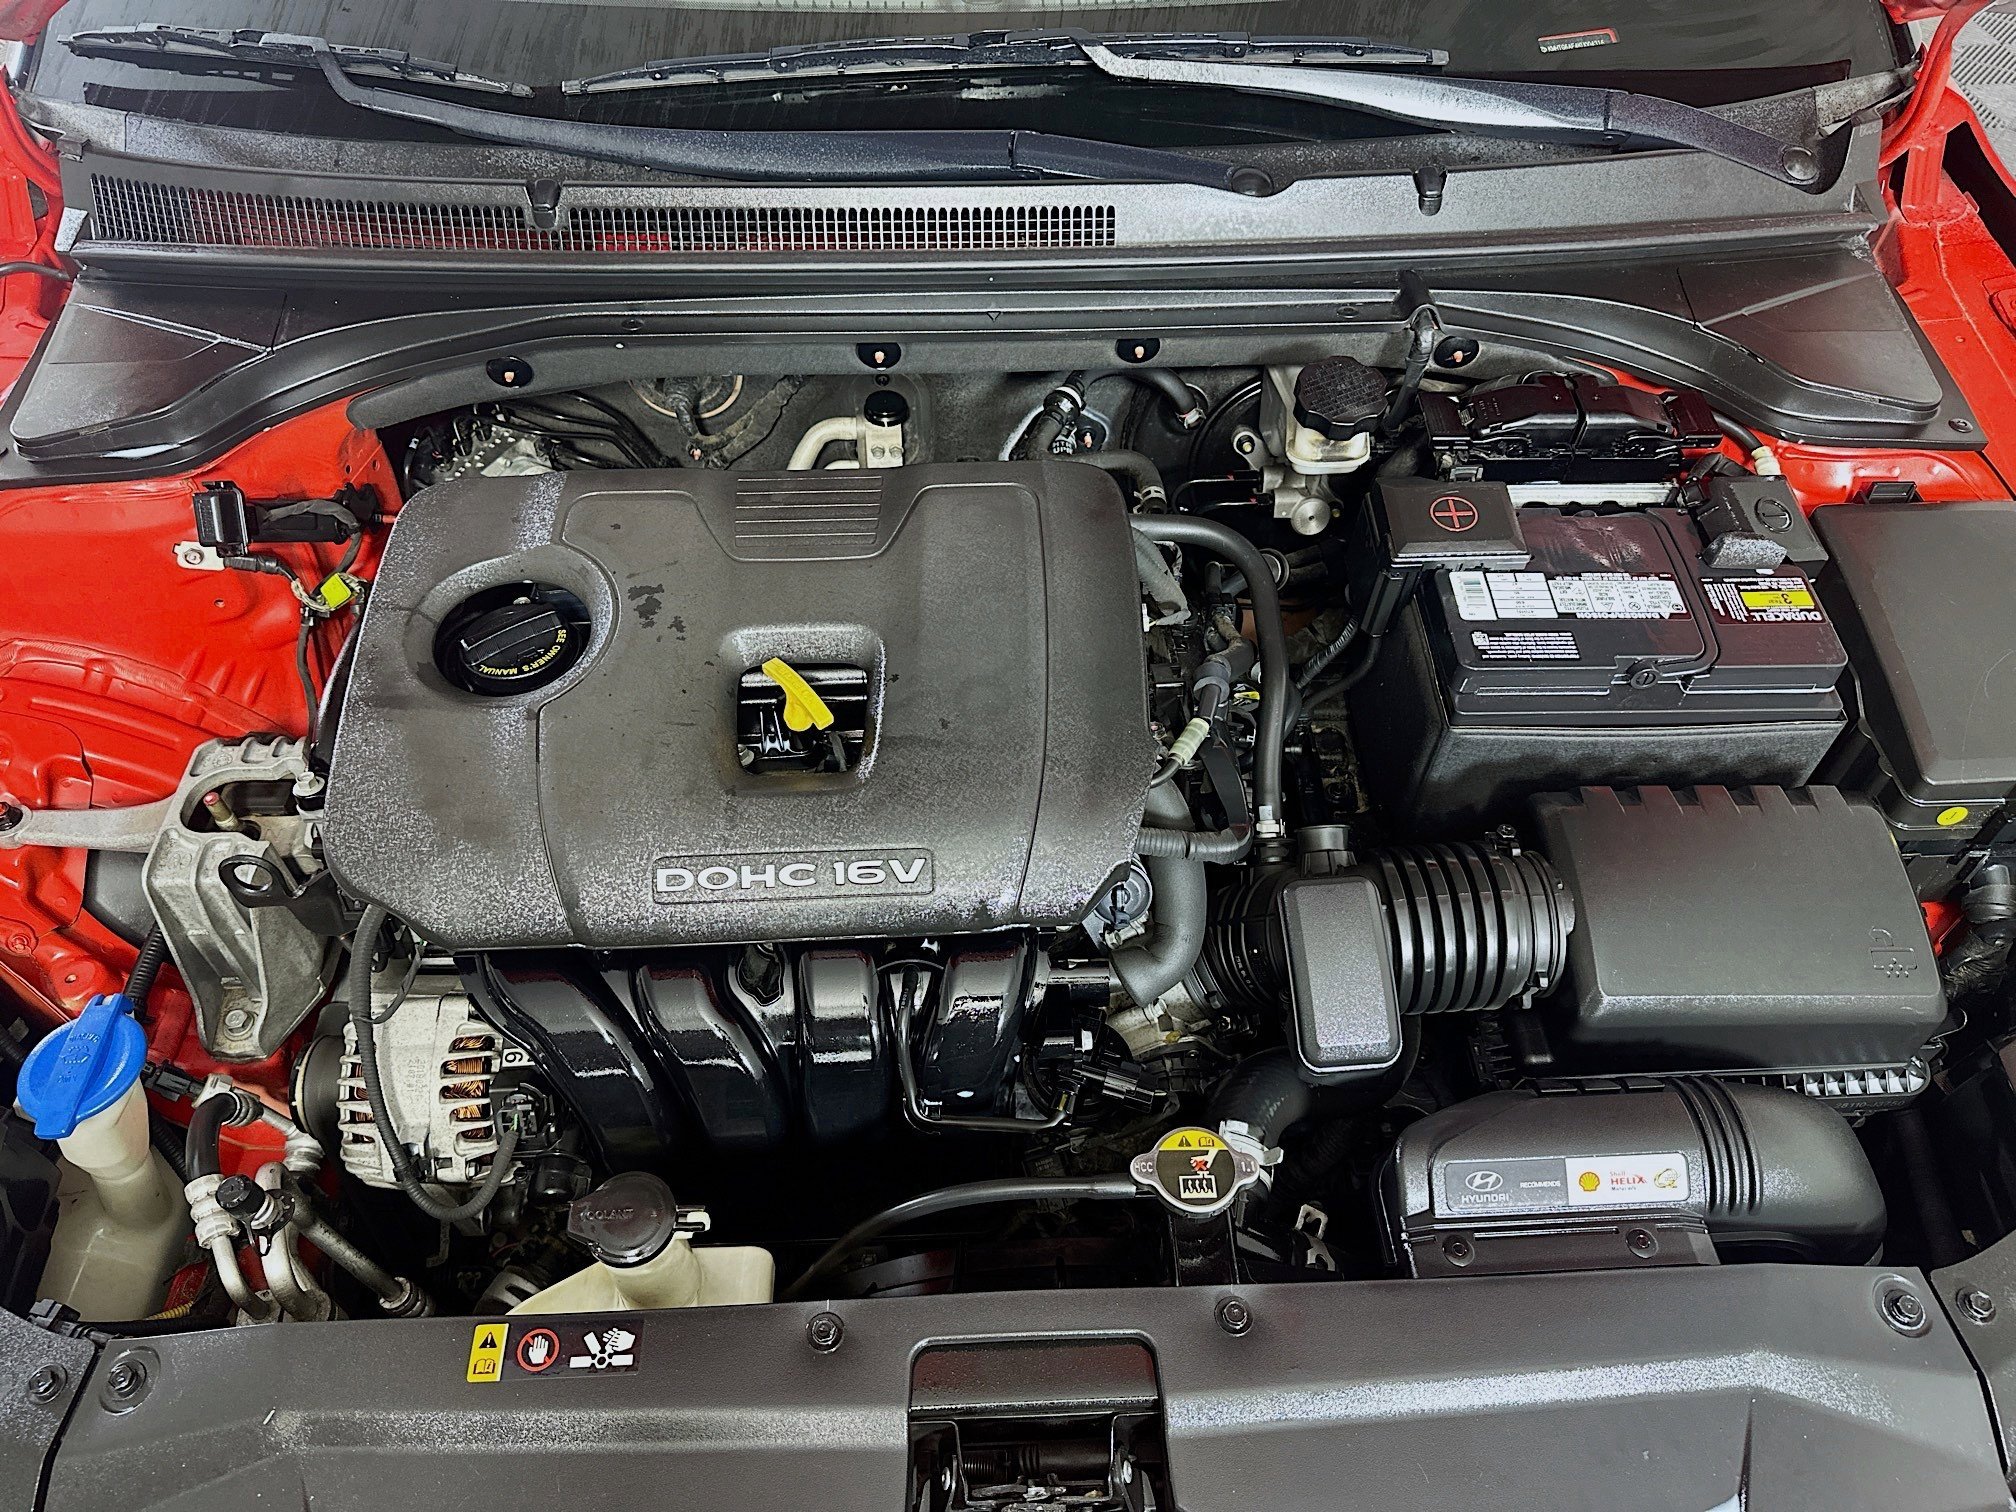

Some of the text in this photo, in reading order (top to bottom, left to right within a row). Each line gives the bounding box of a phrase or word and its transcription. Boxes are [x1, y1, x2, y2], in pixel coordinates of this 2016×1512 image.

[1781, 593, 1793, 604] 3
[1750, 611, 1823, 621] DURACELL
[479, 630, 566, 676] SEE OWNER'S MANUAL
[656, 858, 926, 892] DOHC 16V
[1134, 1161, 1154, 1173] HCC
[1240, 1160, 1255, 1173] 1.1
[1519, 1180, 1561, 1189] RECOMMENDS
[1611, 1175, 1646, 1186] HELIX
[1461, 1193, 1510, 1204] HYUNDAI
[580, 1208, 634, 1222] COOLANT
